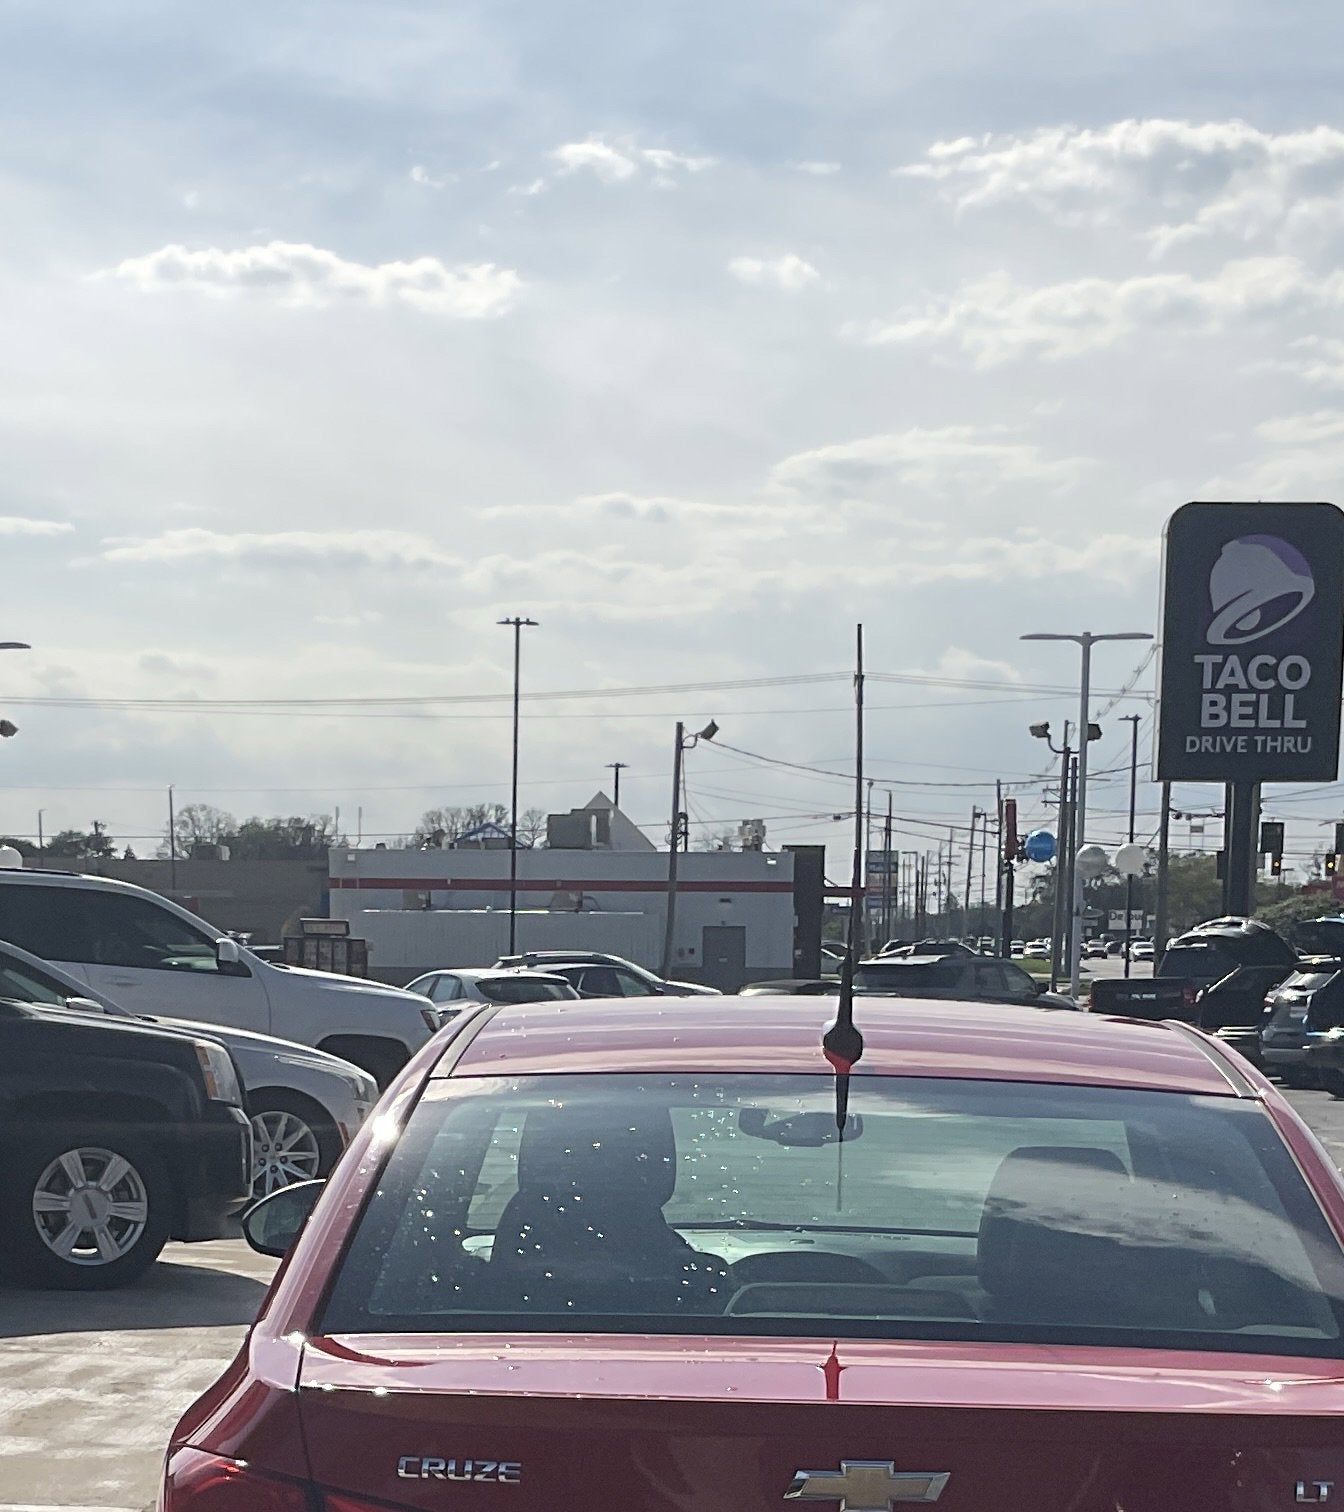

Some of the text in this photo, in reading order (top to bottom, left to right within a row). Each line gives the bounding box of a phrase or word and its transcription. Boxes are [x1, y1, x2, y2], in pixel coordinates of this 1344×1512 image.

[1193, 654, 1312, 690] TACO
[1200, 693, 1307, 728] BELL
[1185, 735, 1312, 753] DRIVE THRU
[397, 1455, 522, 1483] CRUZE
[1295, 1481, 1335, 1503] LT
